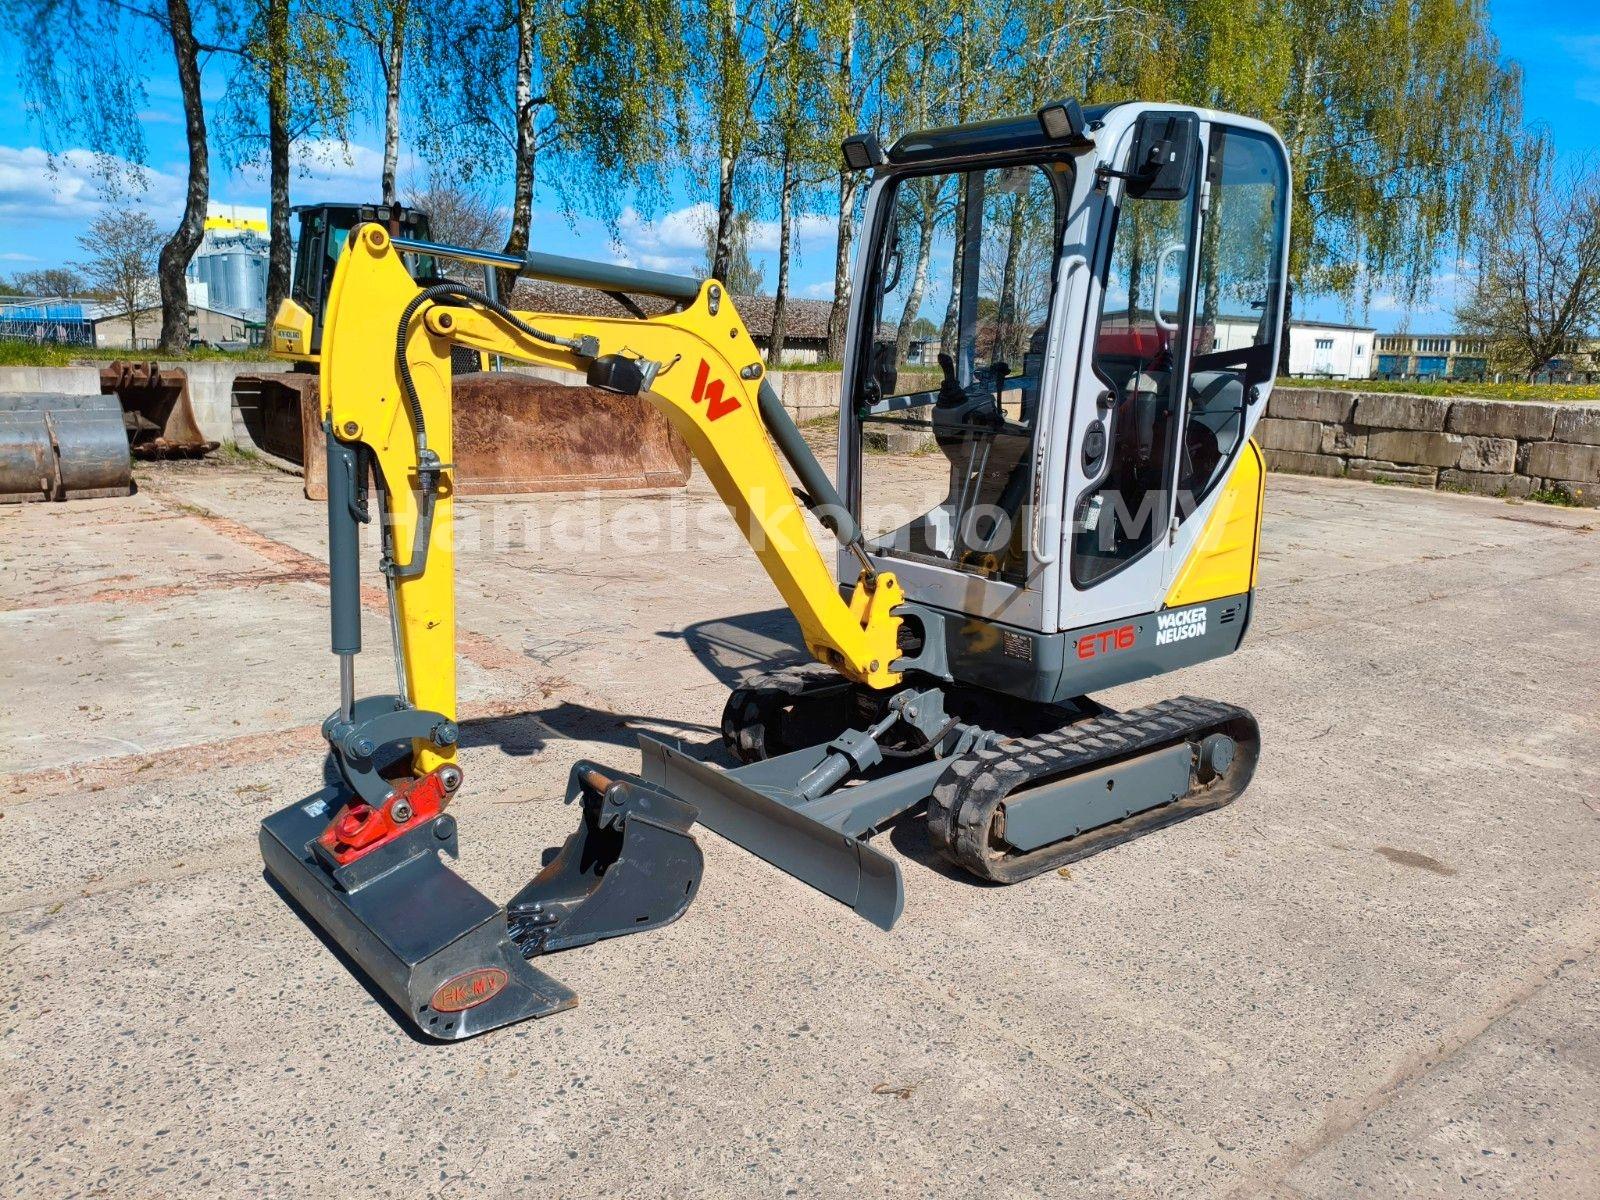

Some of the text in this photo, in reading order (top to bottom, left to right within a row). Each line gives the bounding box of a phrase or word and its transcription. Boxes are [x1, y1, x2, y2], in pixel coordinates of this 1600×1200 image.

[1157, 606, 1207, 630] WACKER
[1077, 624, 1136, 659] ET16
[1156, 621, 1207, 646] NEUSON
